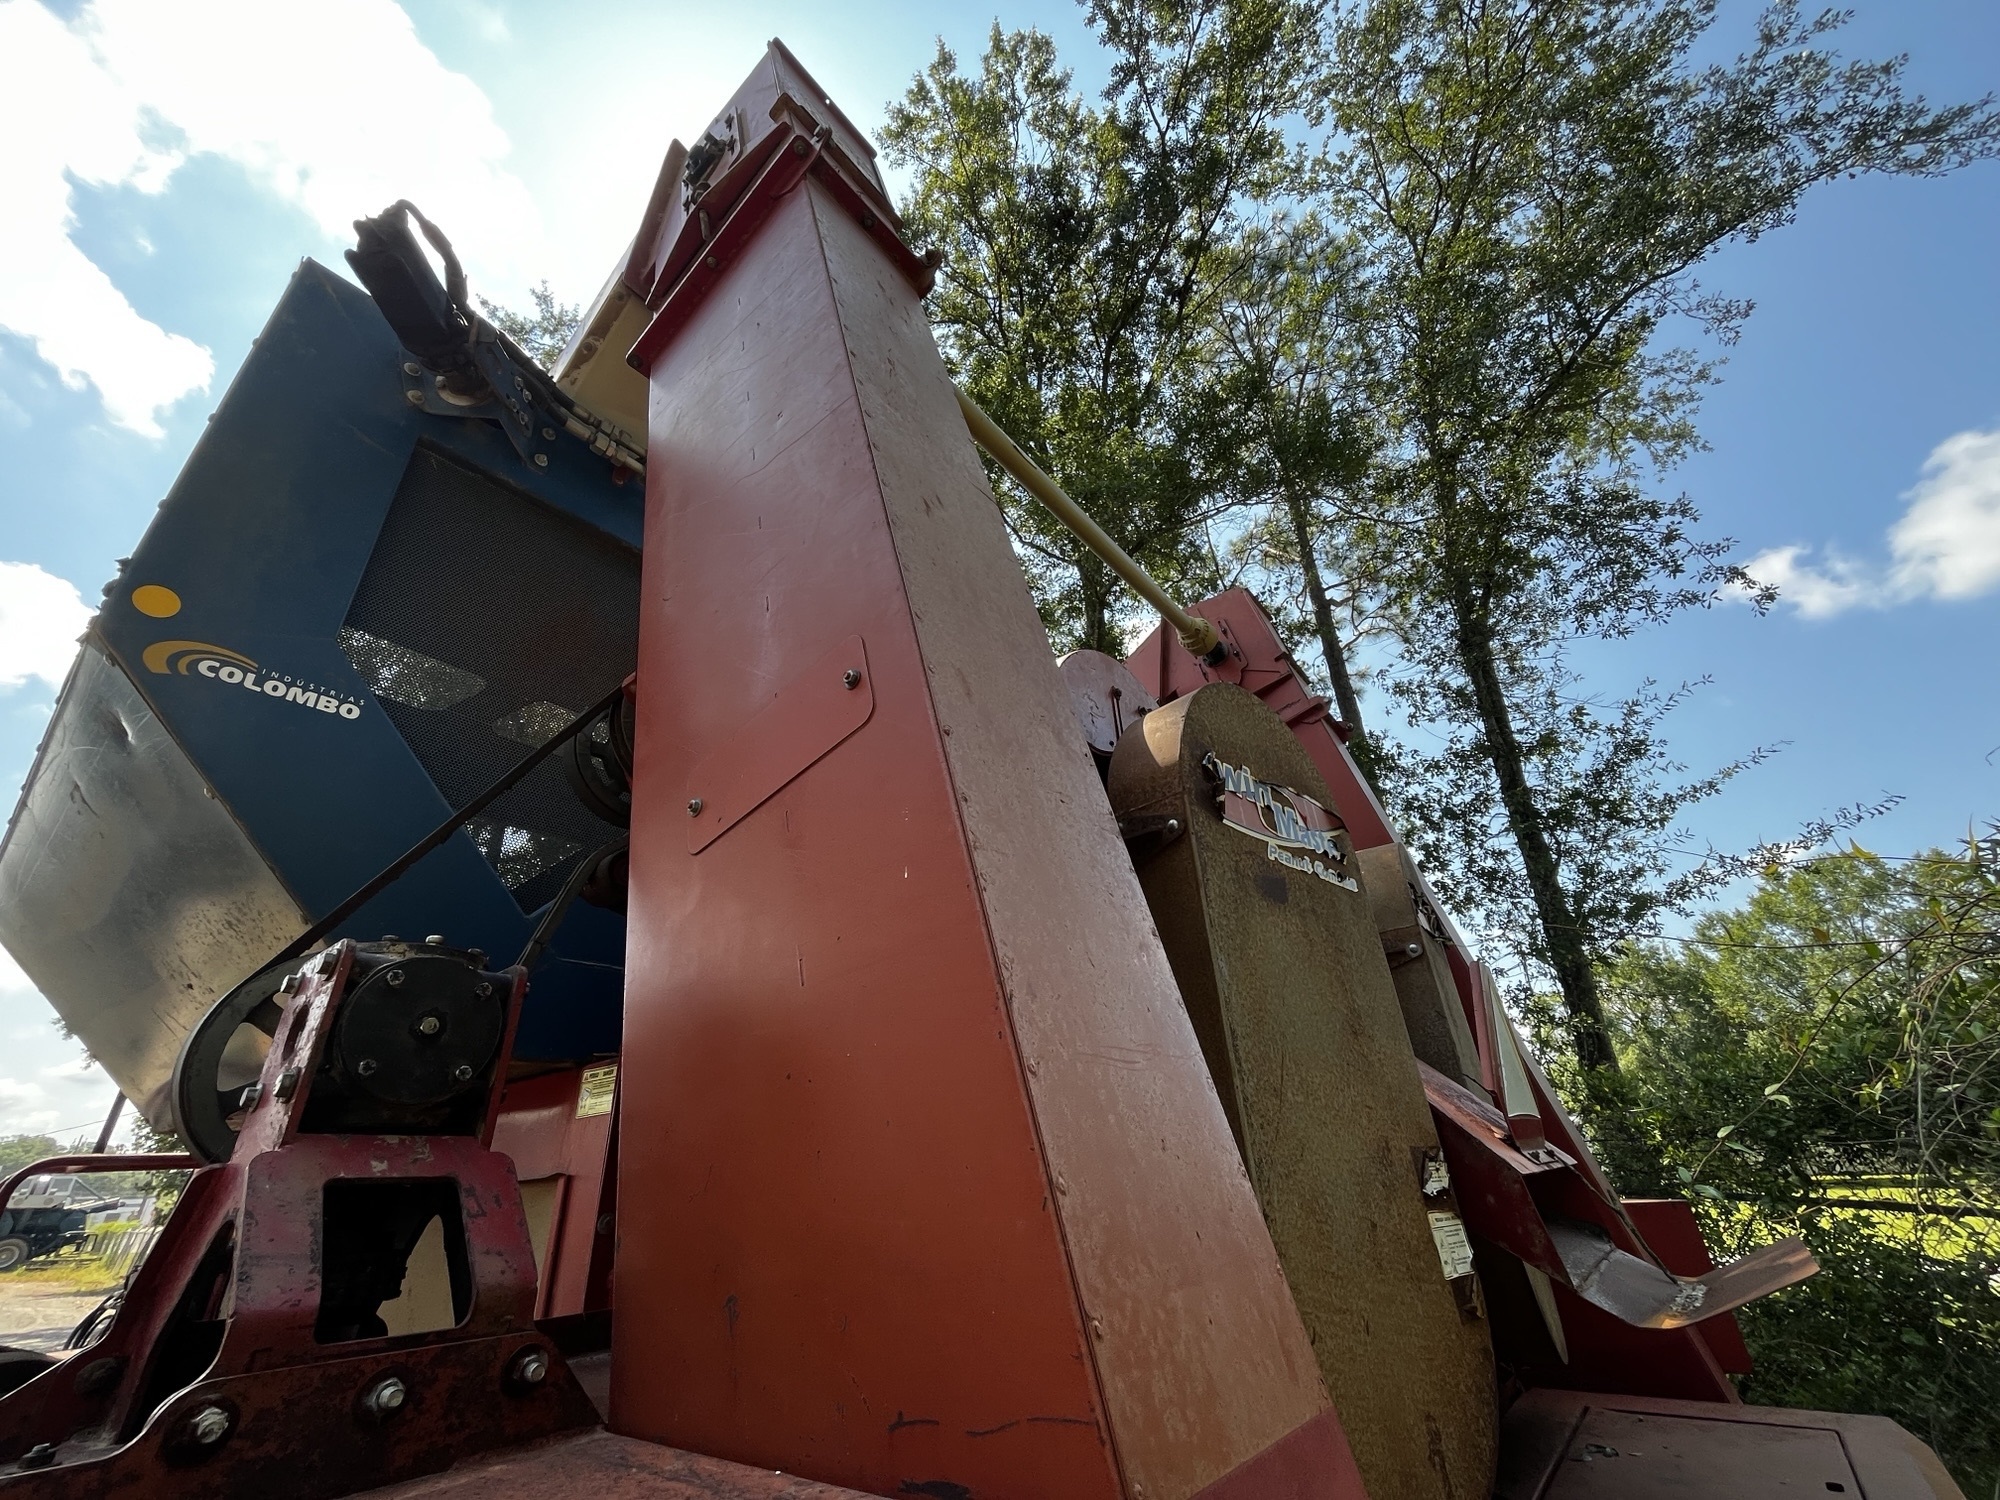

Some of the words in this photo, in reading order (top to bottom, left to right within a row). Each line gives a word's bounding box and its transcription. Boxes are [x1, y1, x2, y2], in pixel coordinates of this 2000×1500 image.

[197, 660, 361, 720] COLOMBO
[261, 668, 365, 706] INDÚSTRIAS
[1268, 841, 1313, 874] Peanut
